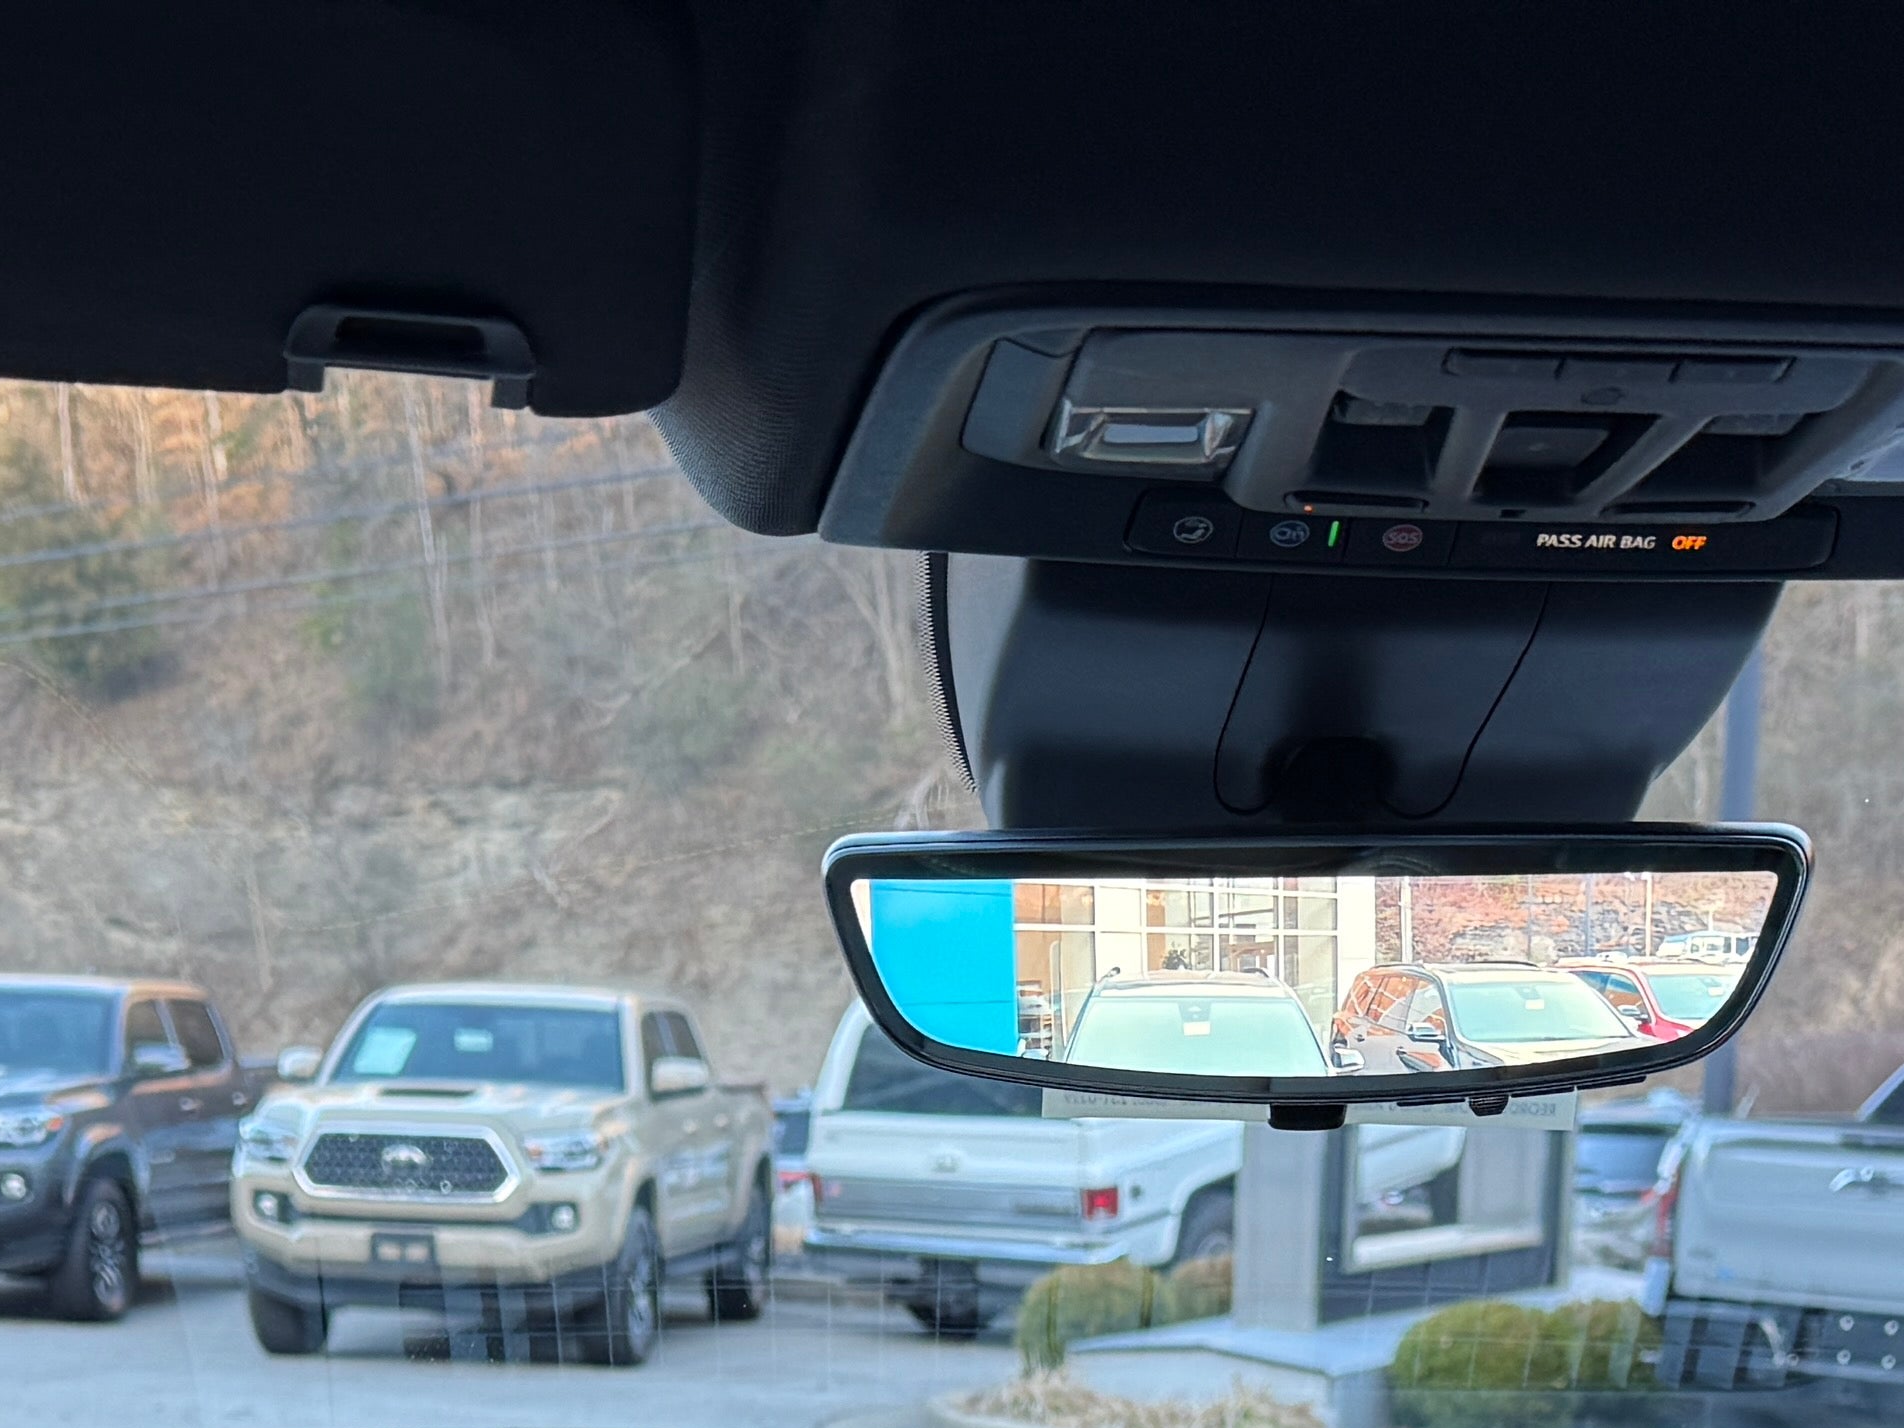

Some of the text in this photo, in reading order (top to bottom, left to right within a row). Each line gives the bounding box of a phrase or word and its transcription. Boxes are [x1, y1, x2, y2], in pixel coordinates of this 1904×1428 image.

[1387, 532, 1419, 544] SOS
[1536, 533, 1707, 550] PASS AIR BAG OFF
